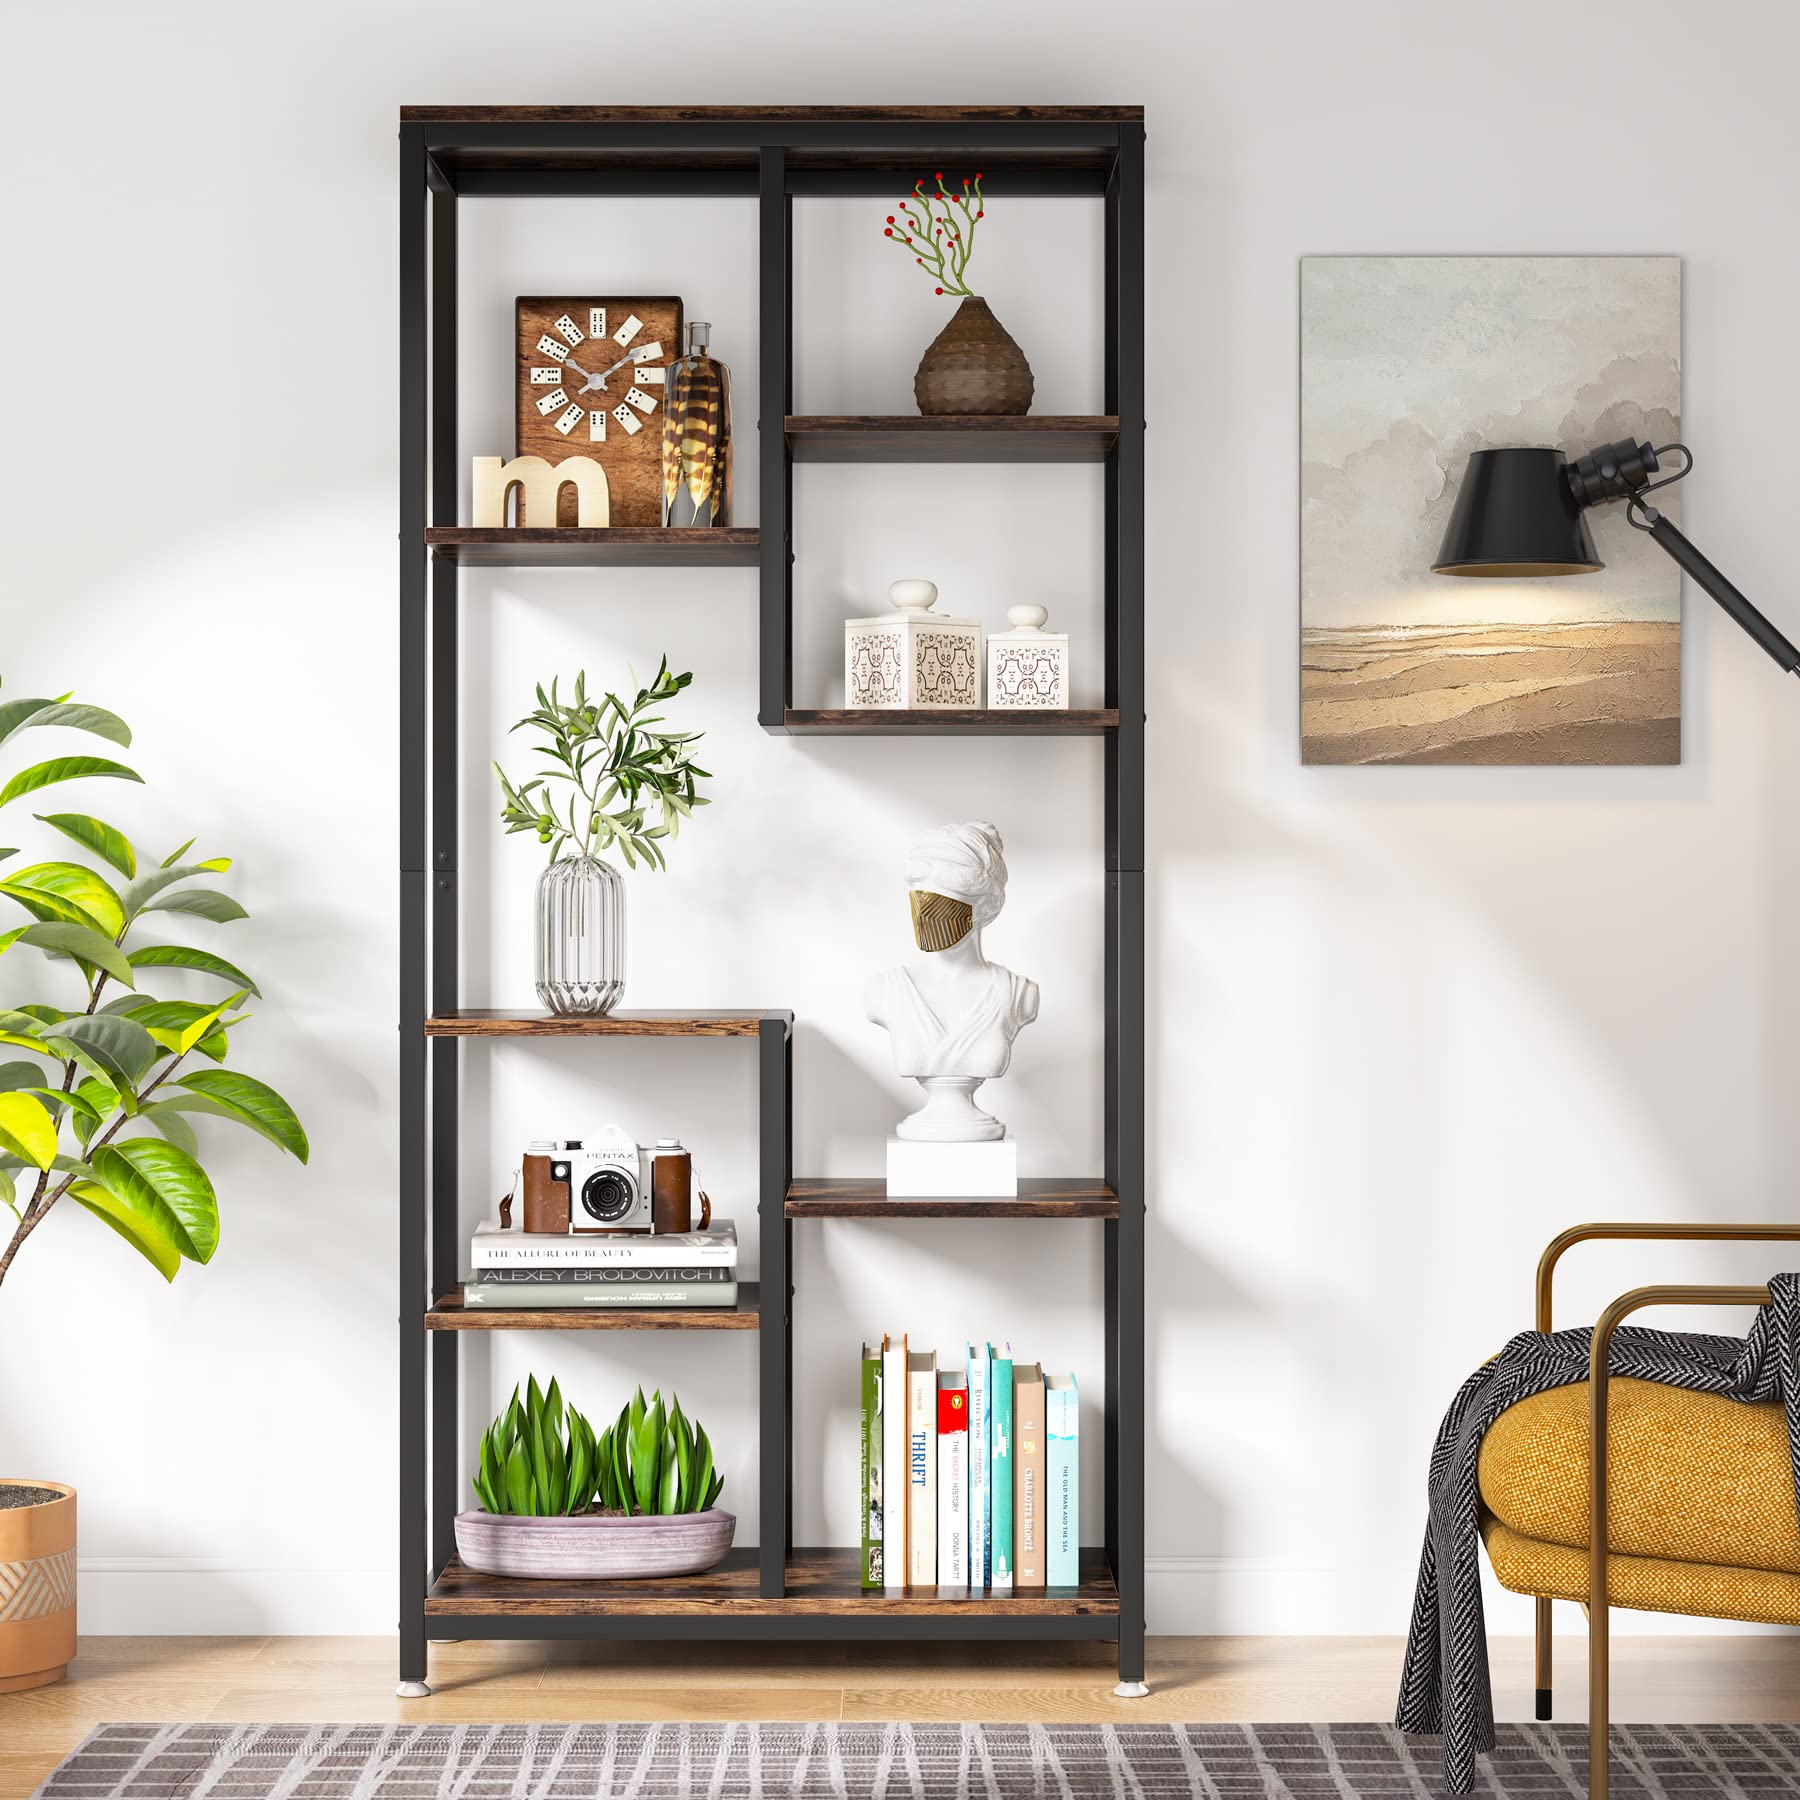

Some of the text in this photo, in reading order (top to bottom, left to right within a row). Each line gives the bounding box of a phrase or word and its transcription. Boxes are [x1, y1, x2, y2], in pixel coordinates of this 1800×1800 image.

[472, 455, 611, 528] m
[483, 1270, 568, 1281] ALEXEY
[573, 1269, 712, 1280] BRODOVITCH
[487, 1250, 634, 1258] THE ALLURE OF BEAUTY
[912, 1431, 926, 1487] THRIFT
[951, 1440, 960, 1513] THE SECRET HISTORY
[1023, 1467, 1033, 1517] CHARLOTTE
[952, 1532, 960, 1580] DONNA TARTT
